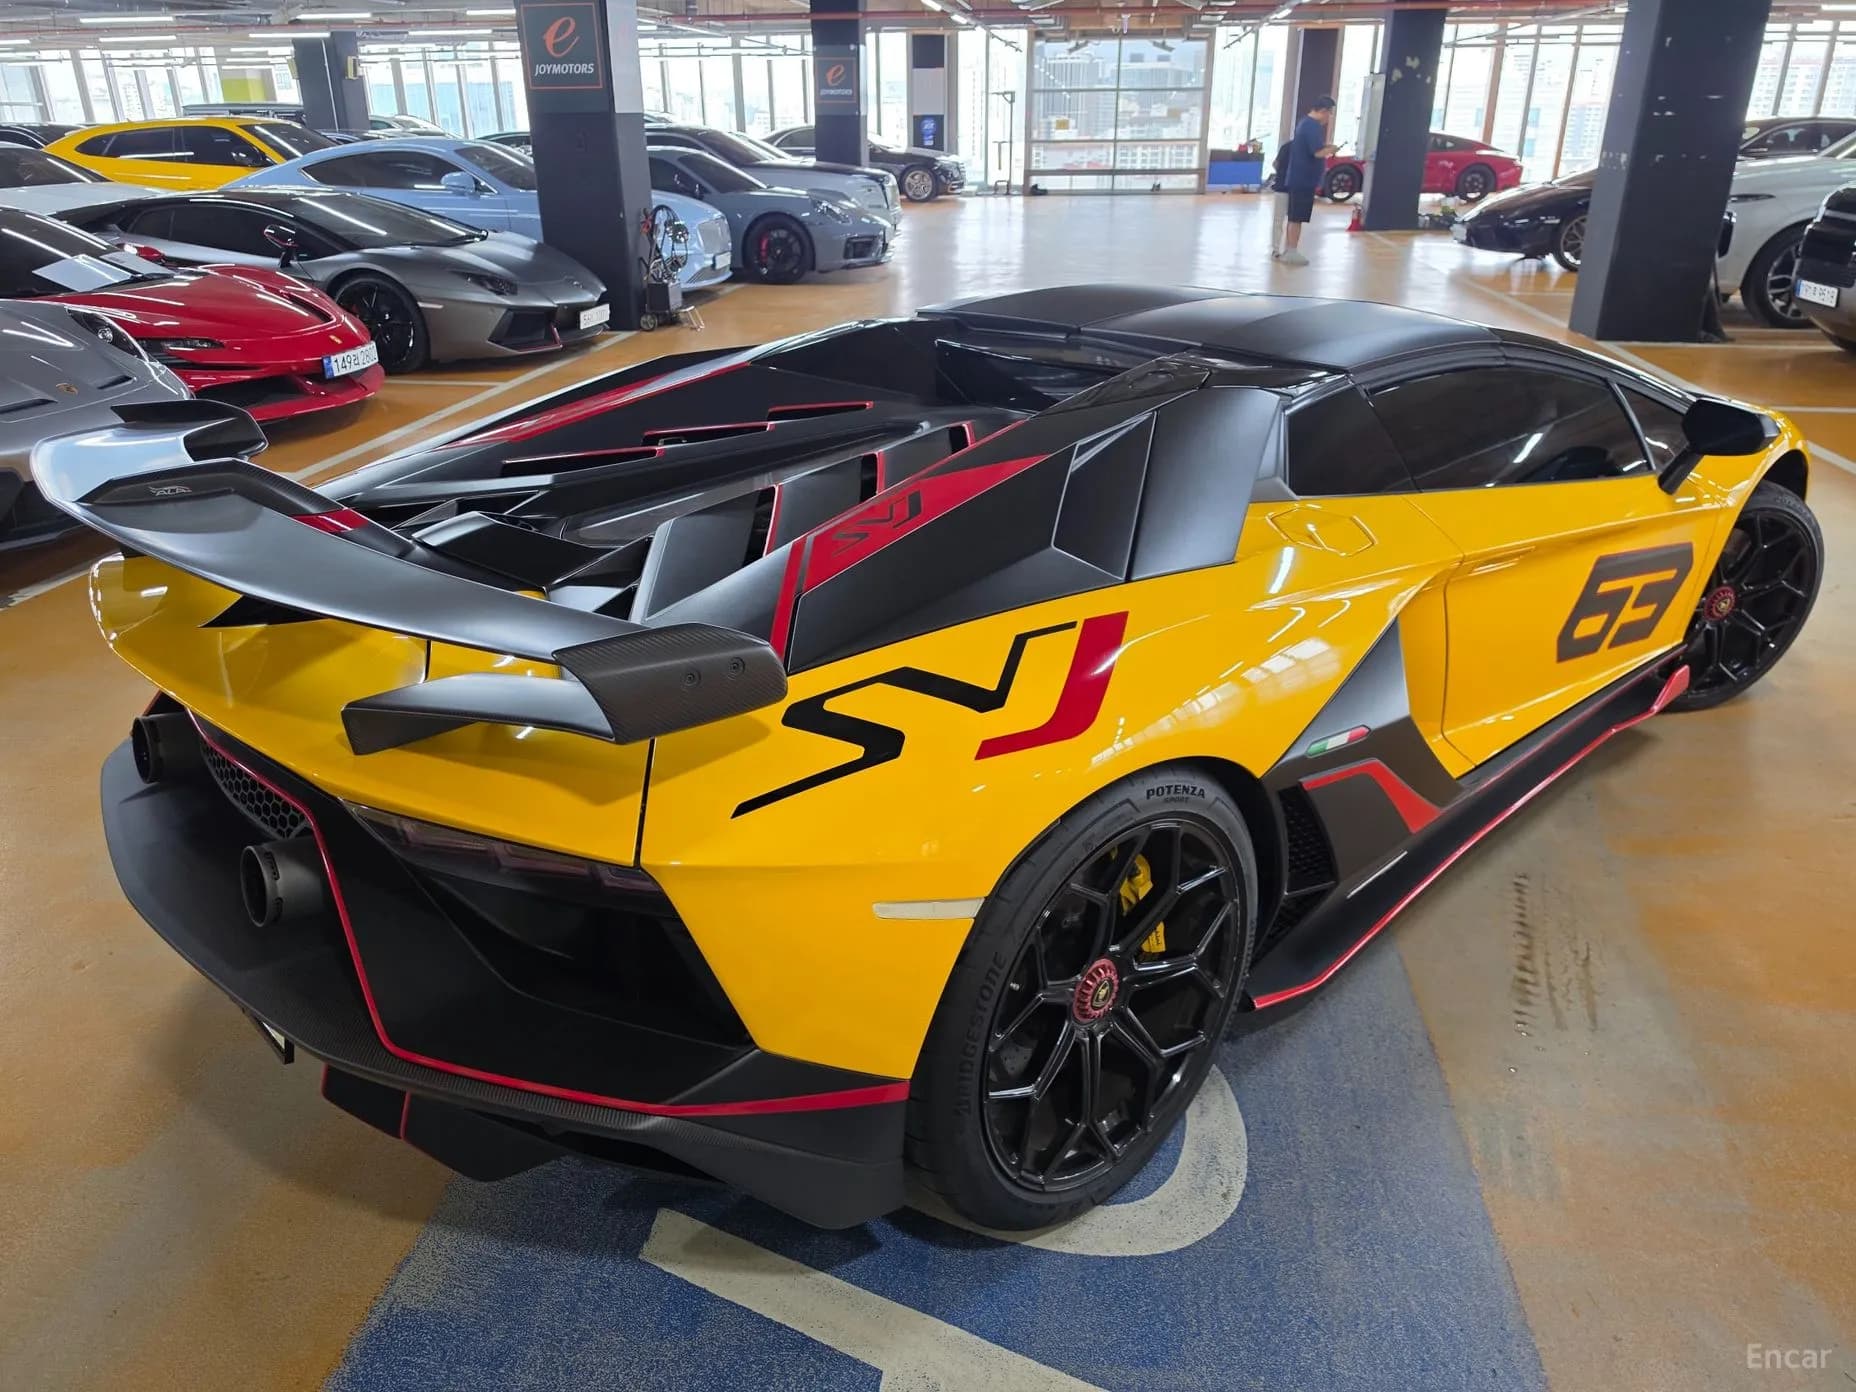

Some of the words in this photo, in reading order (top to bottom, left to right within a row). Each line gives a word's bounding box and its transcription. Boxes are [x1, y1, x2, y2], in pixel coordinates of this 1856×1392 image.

[534, 63, 595, 76] JOYMOTORS
[1556, 542, 1694, 664] 63
[730, 610, 1129, 819] SVJ
[1145, 784, 1205, 800] POTENZA
